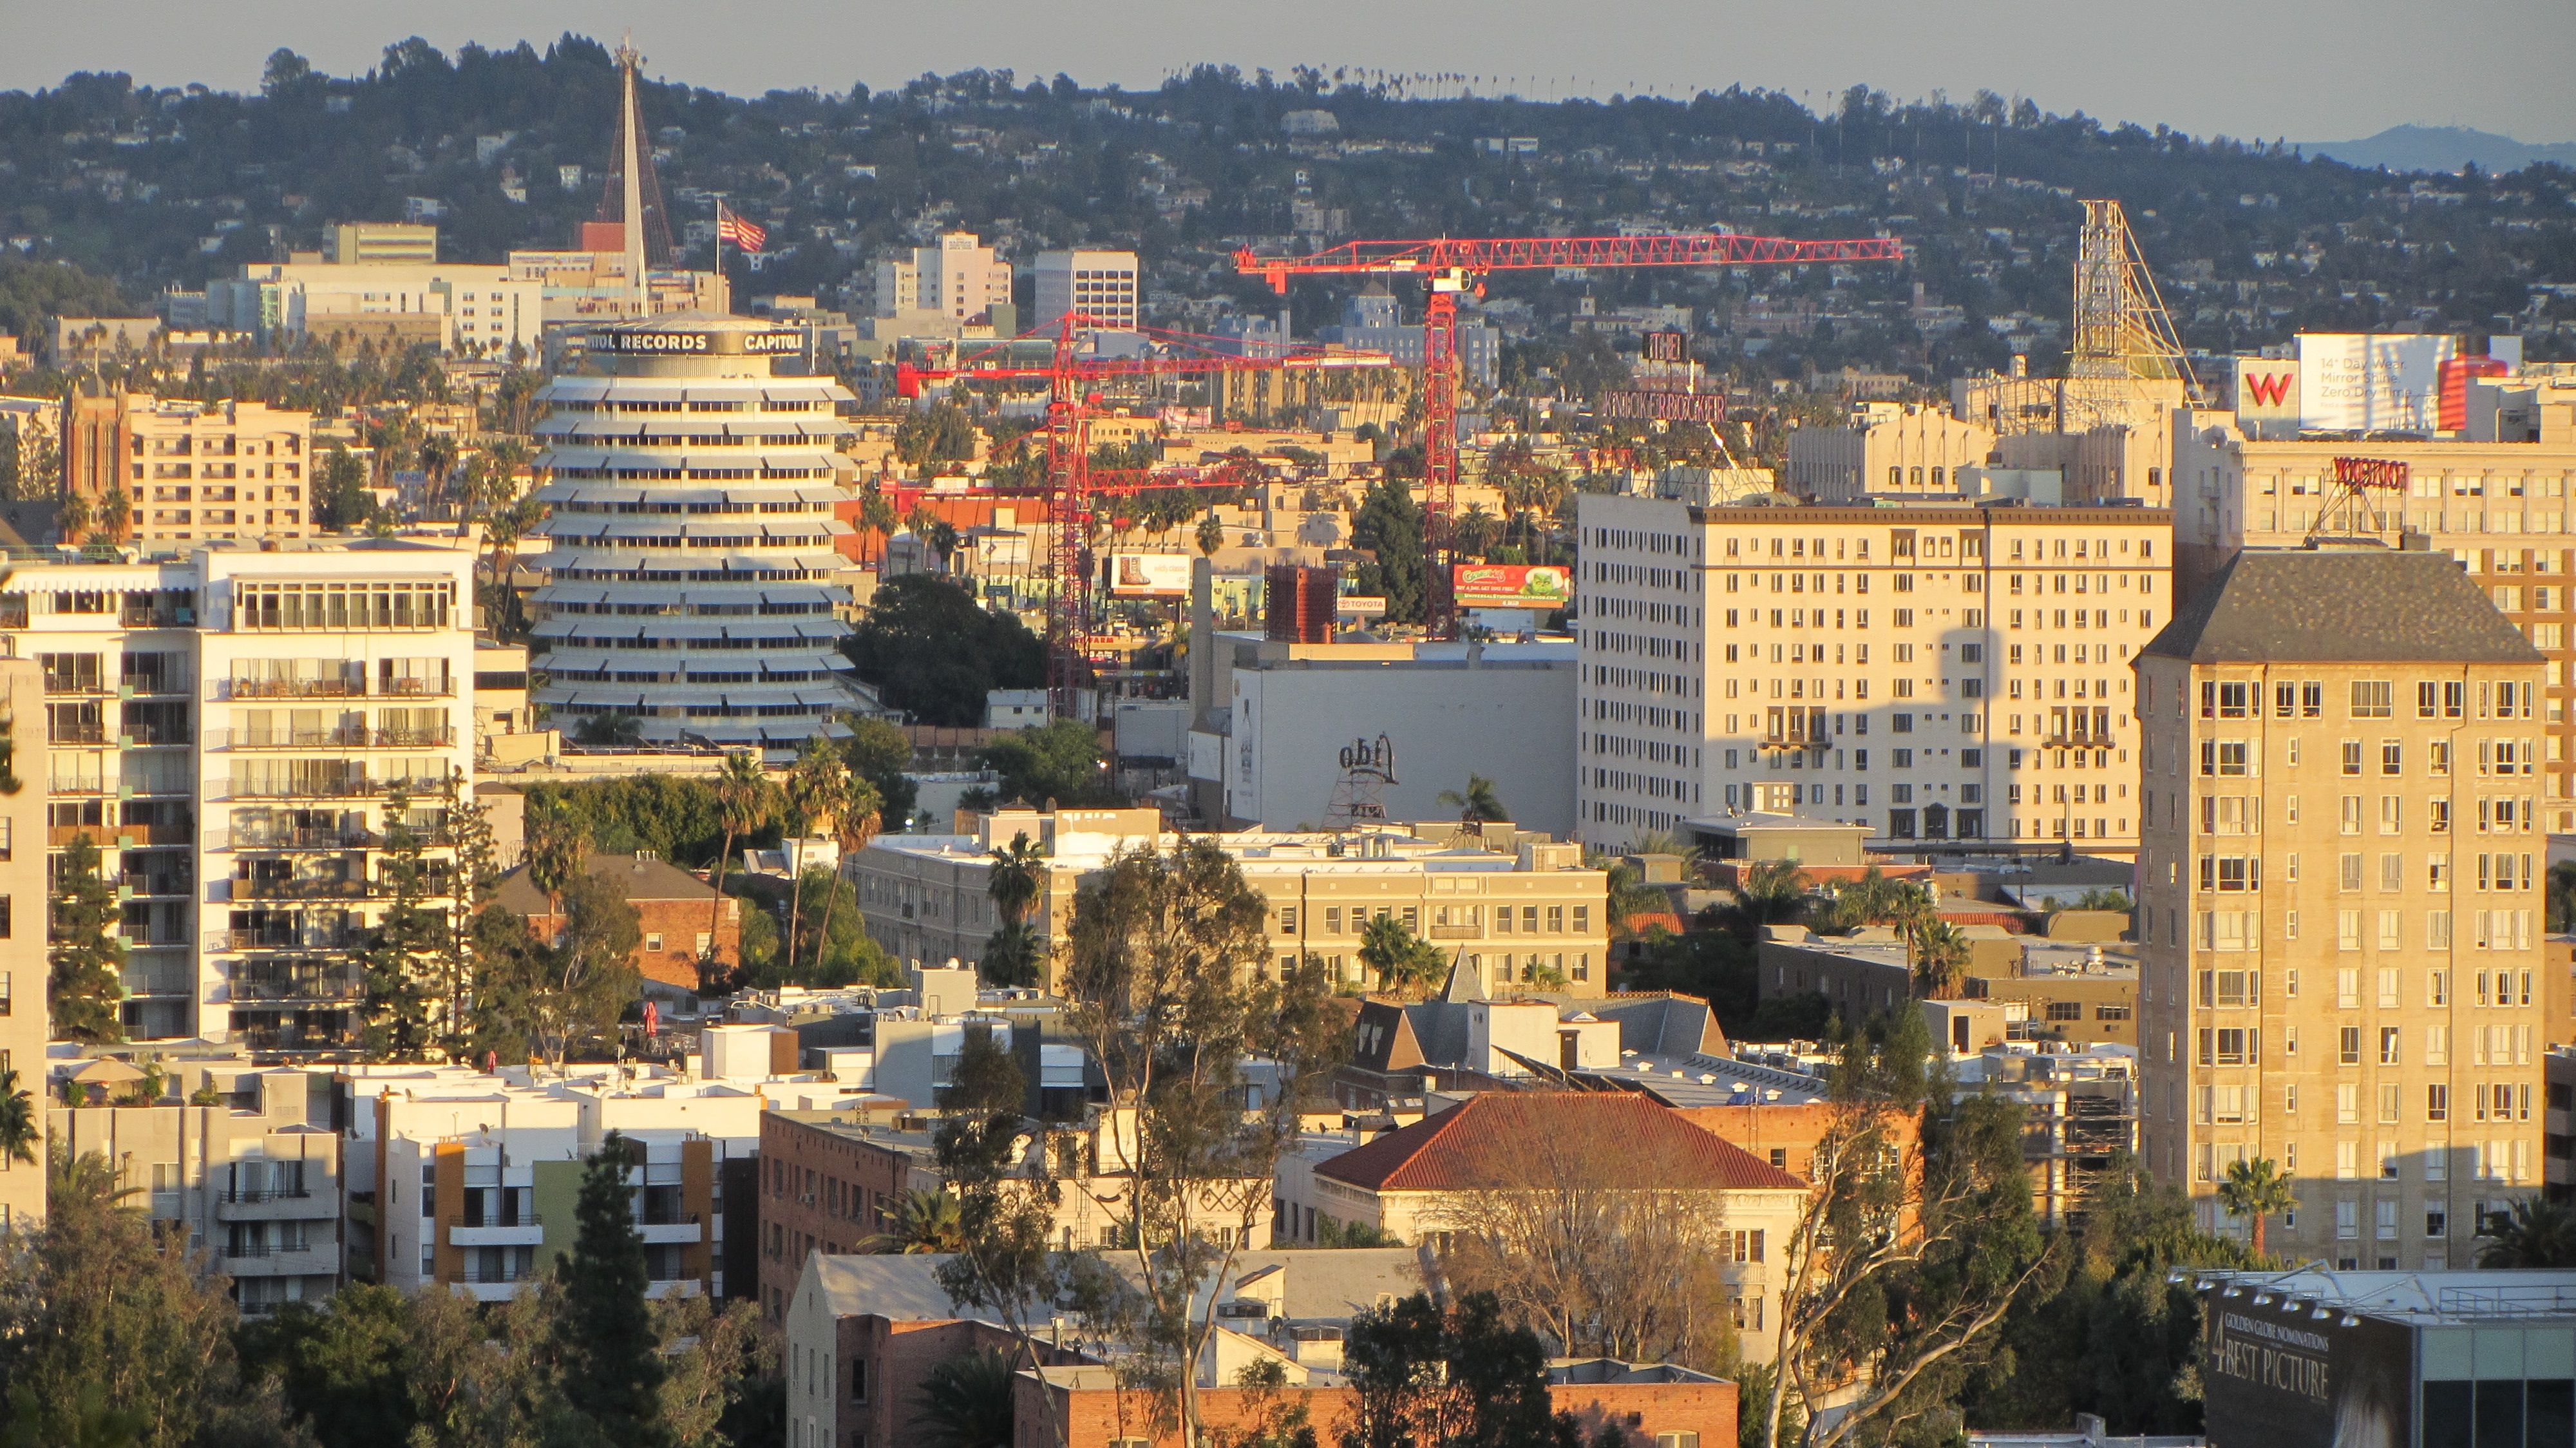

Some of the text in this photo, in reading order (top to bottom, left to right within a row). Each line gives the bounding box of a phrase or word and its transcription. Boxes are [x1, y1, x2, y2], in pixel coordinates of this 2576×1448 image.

[620, 334, 707, 350] RECORDS
[744, 334, 797, 350] CAPITOL
[1649, 332, 1680, 360] THE
[2344, 358, 2367, 370] Day
[2373, 358, 2407, 369] Wear.
[2321, 372, 2401, 383] Mirror Shine.
[2246, 372, 2293, 406] W
[2321, 386, 2352, 397] Zero
[2354, 386, 2376, 399] Dry
[1604, 390, 1726, 422] KNICKERBOCKER
[2211, 1311, 2329, 1373] 4 GOLDEN GLOBE NOMINATIONS
[2226, 1338, 2329, 1400] BEST PICTURE
